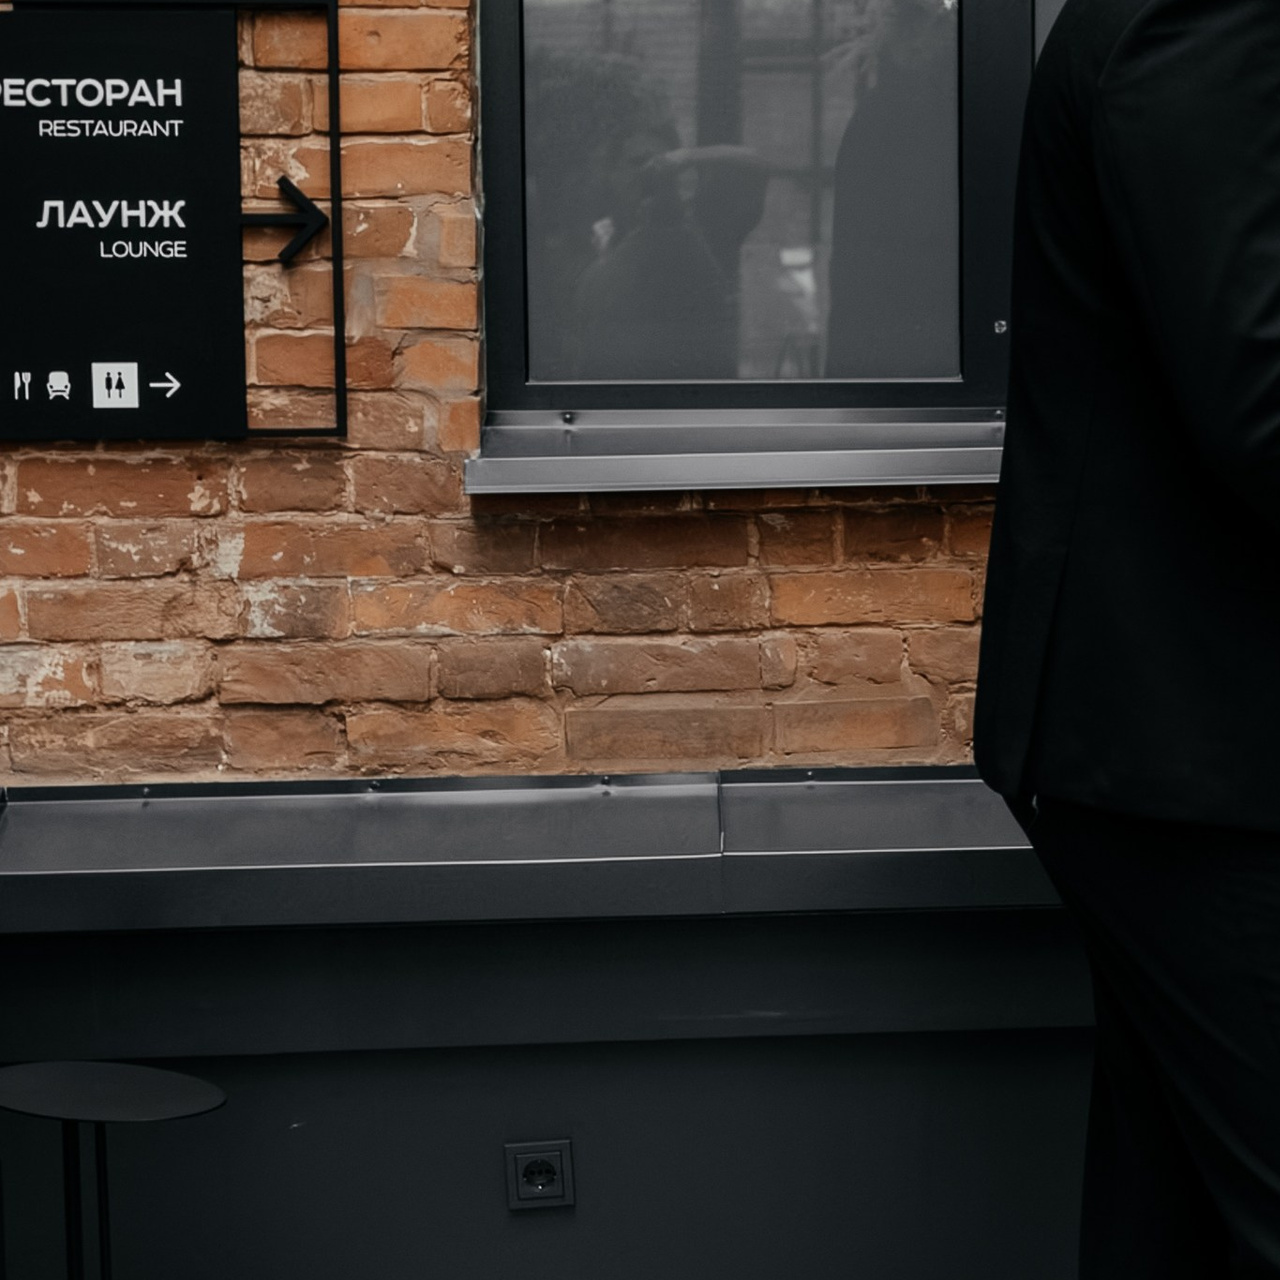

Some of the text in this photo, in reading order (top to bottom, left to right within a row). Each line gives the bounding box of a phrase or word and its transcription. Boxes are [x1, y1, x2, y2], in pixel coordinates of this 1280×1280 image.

[0, 77, 183, 108] ЕСТОРАН
[38, 119, 184, 138] RESTAURANT
[35, 199, 186, 229] ЛАУНЖ
[99, 240, 188, 259] LOUNGE
